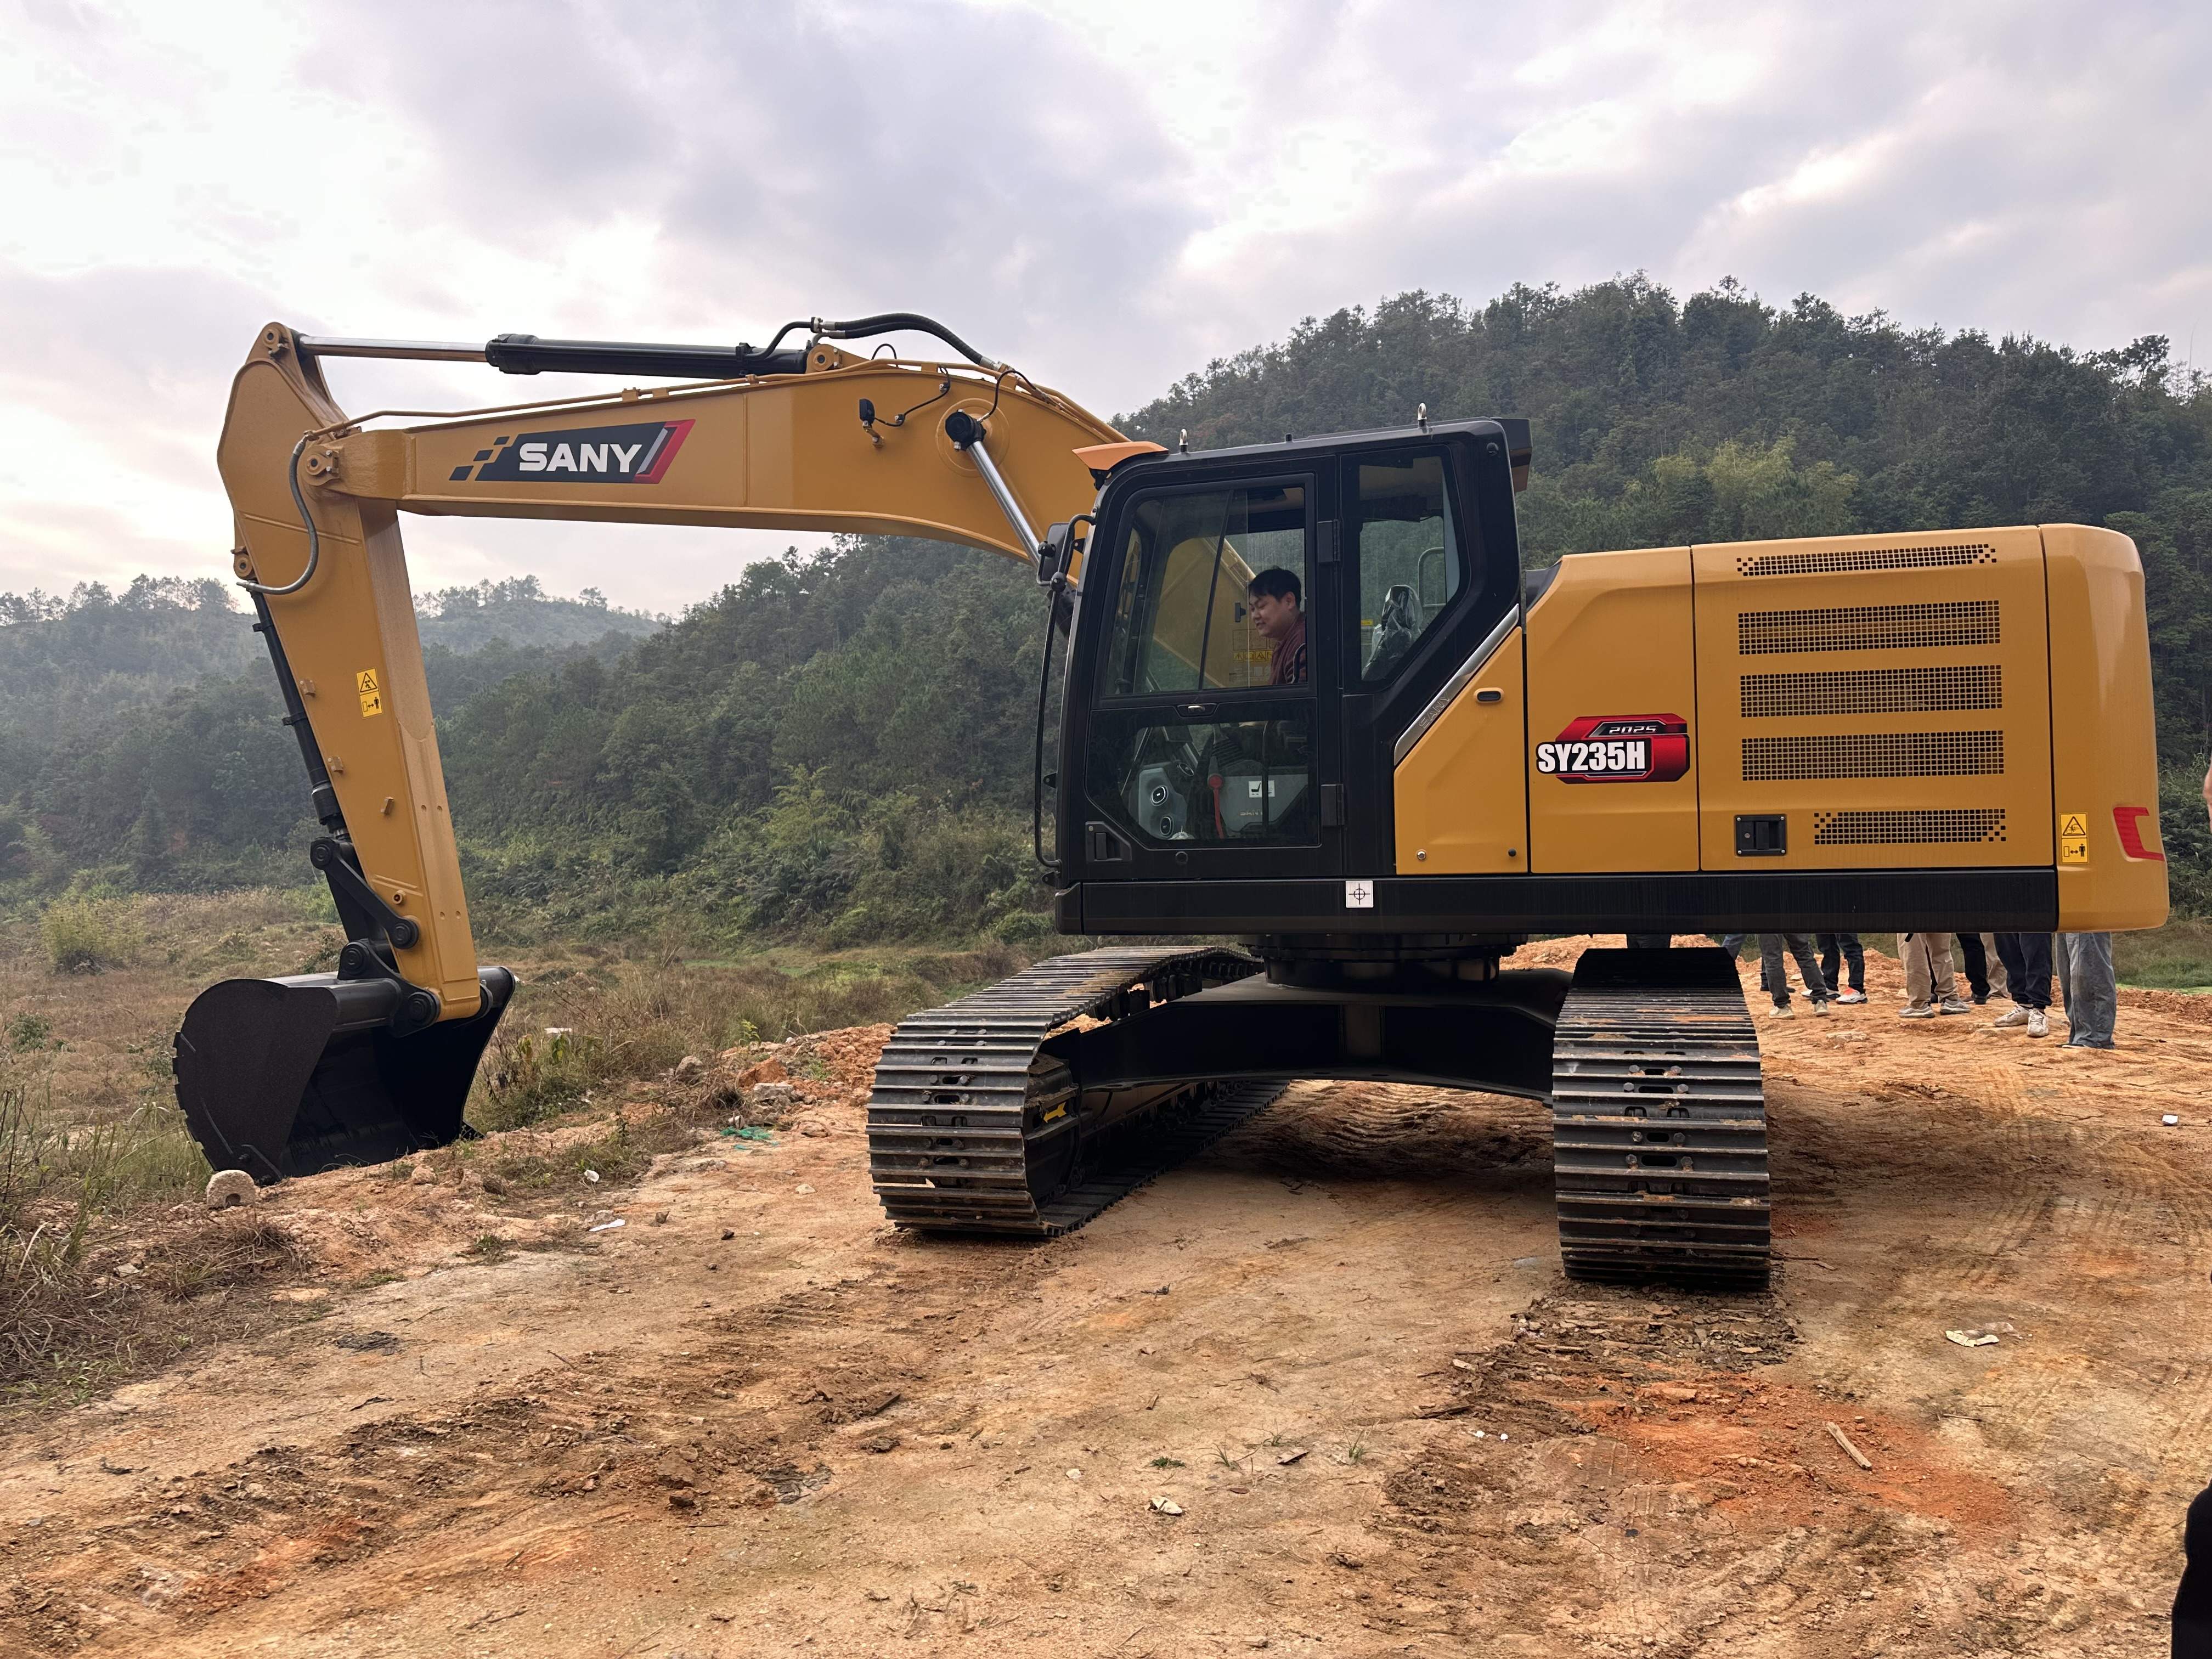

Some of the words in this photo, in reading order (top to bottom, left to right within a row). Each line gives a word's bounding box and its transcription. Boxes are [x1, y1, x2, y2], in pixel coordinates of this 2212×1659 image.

[519, 443, 642, 473] SANY
[1419, 691, 1450, 729] SANY
[1609, 725, 1657, 735] 2025
[1538, 741, 1645, 772] SY235H
